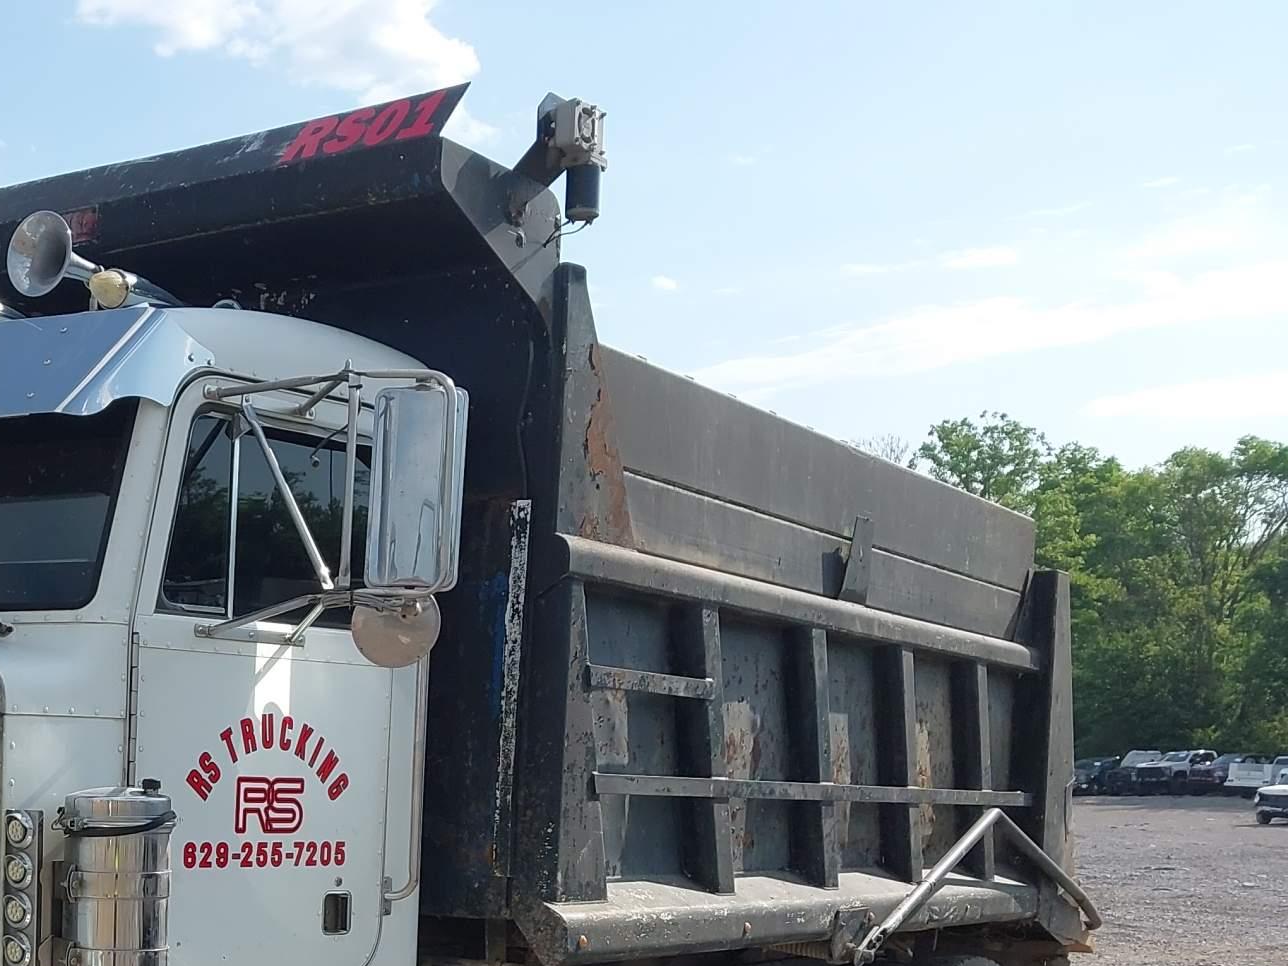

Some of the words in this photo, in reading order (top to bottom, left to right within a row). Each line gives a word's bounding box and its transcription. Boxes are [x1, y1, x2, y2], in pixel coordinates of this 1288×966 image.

[280, 90, 448, 163] RS01
[186, 752, 221, 800] RS
[220, 713, 349, 800] TRUCKING
[234, 776, 305, 834] RS
[183, 841, 346, 868] 629-255-7205
